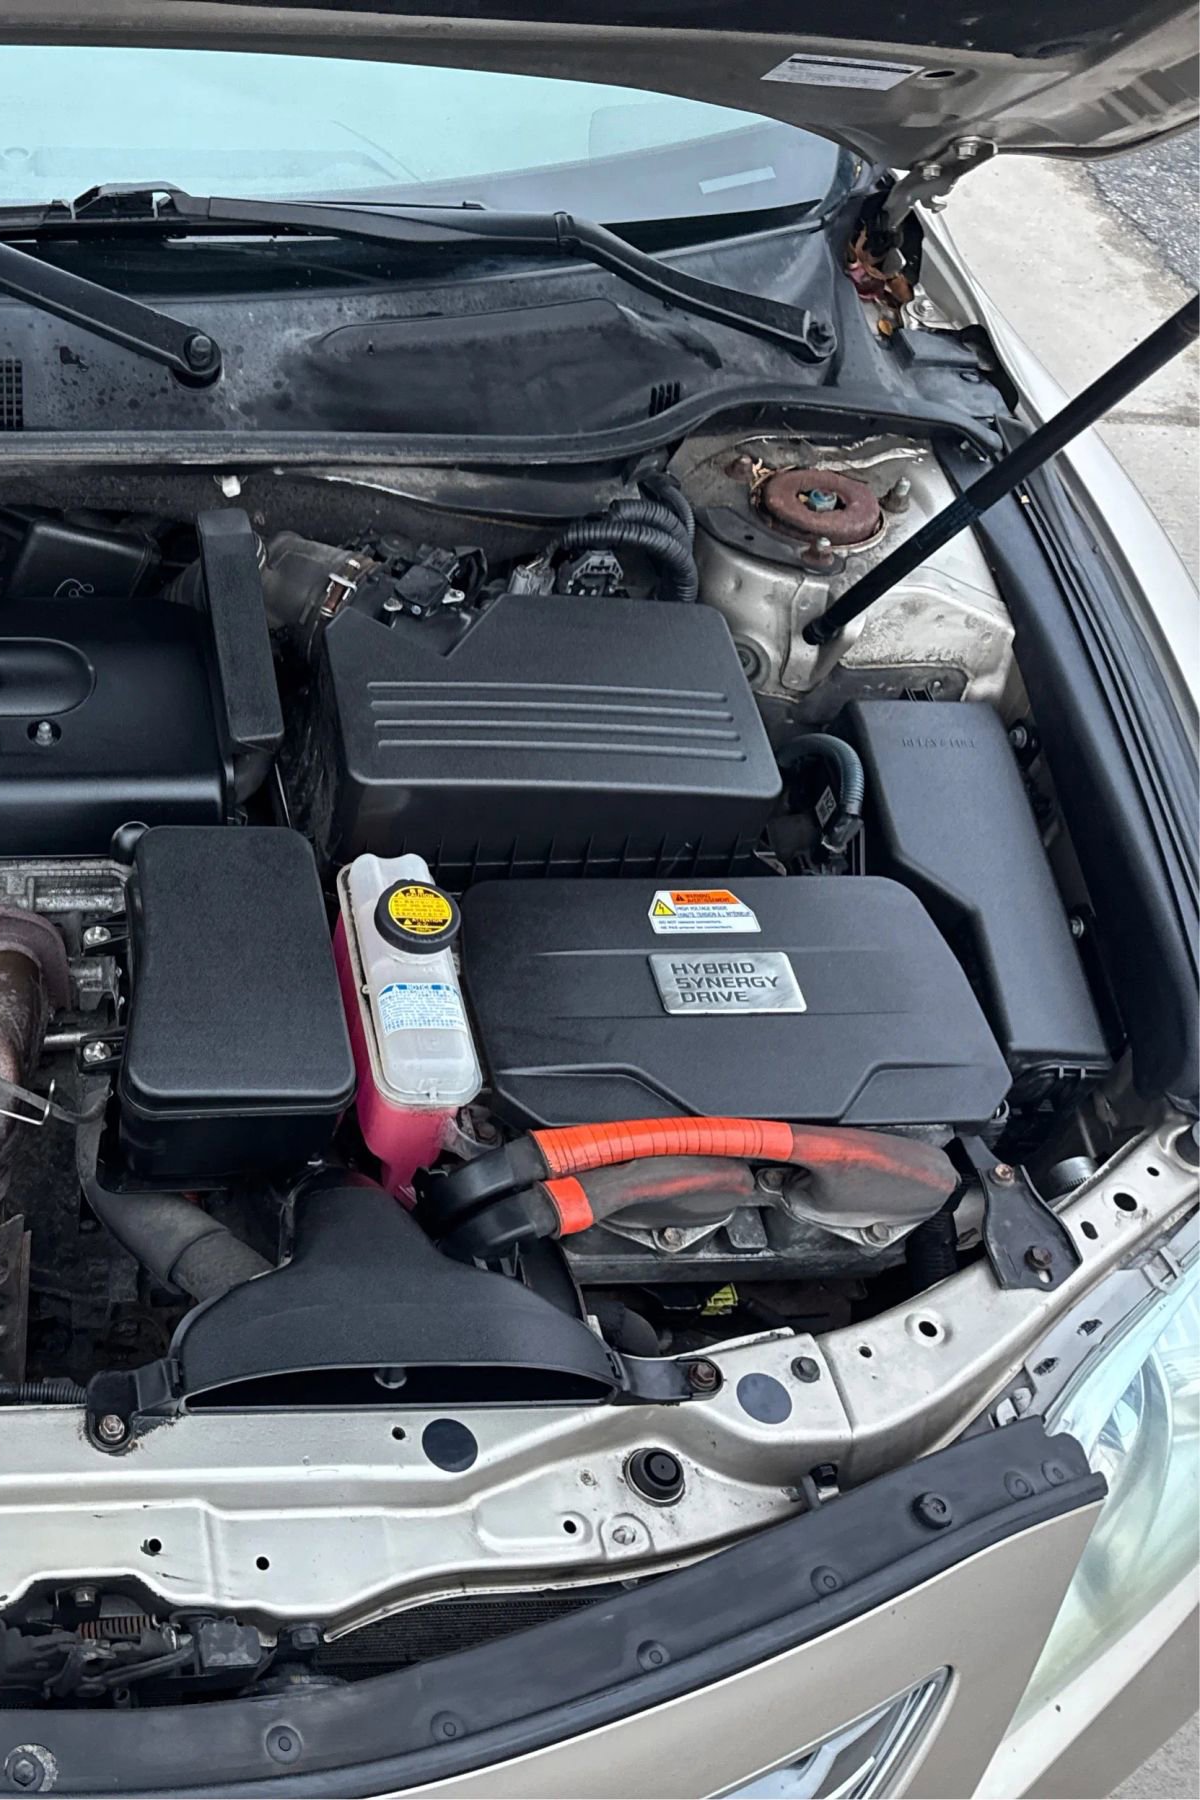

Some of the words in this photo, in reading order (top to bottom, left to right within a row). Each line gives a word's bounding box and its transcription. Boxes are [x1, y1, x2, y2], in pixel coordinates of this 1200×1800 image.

[670, 962, 755, 974] HYBRID
[675, 976, 779, 989] SYNERGY
[679, 991, 750, 1003] DRIVE
